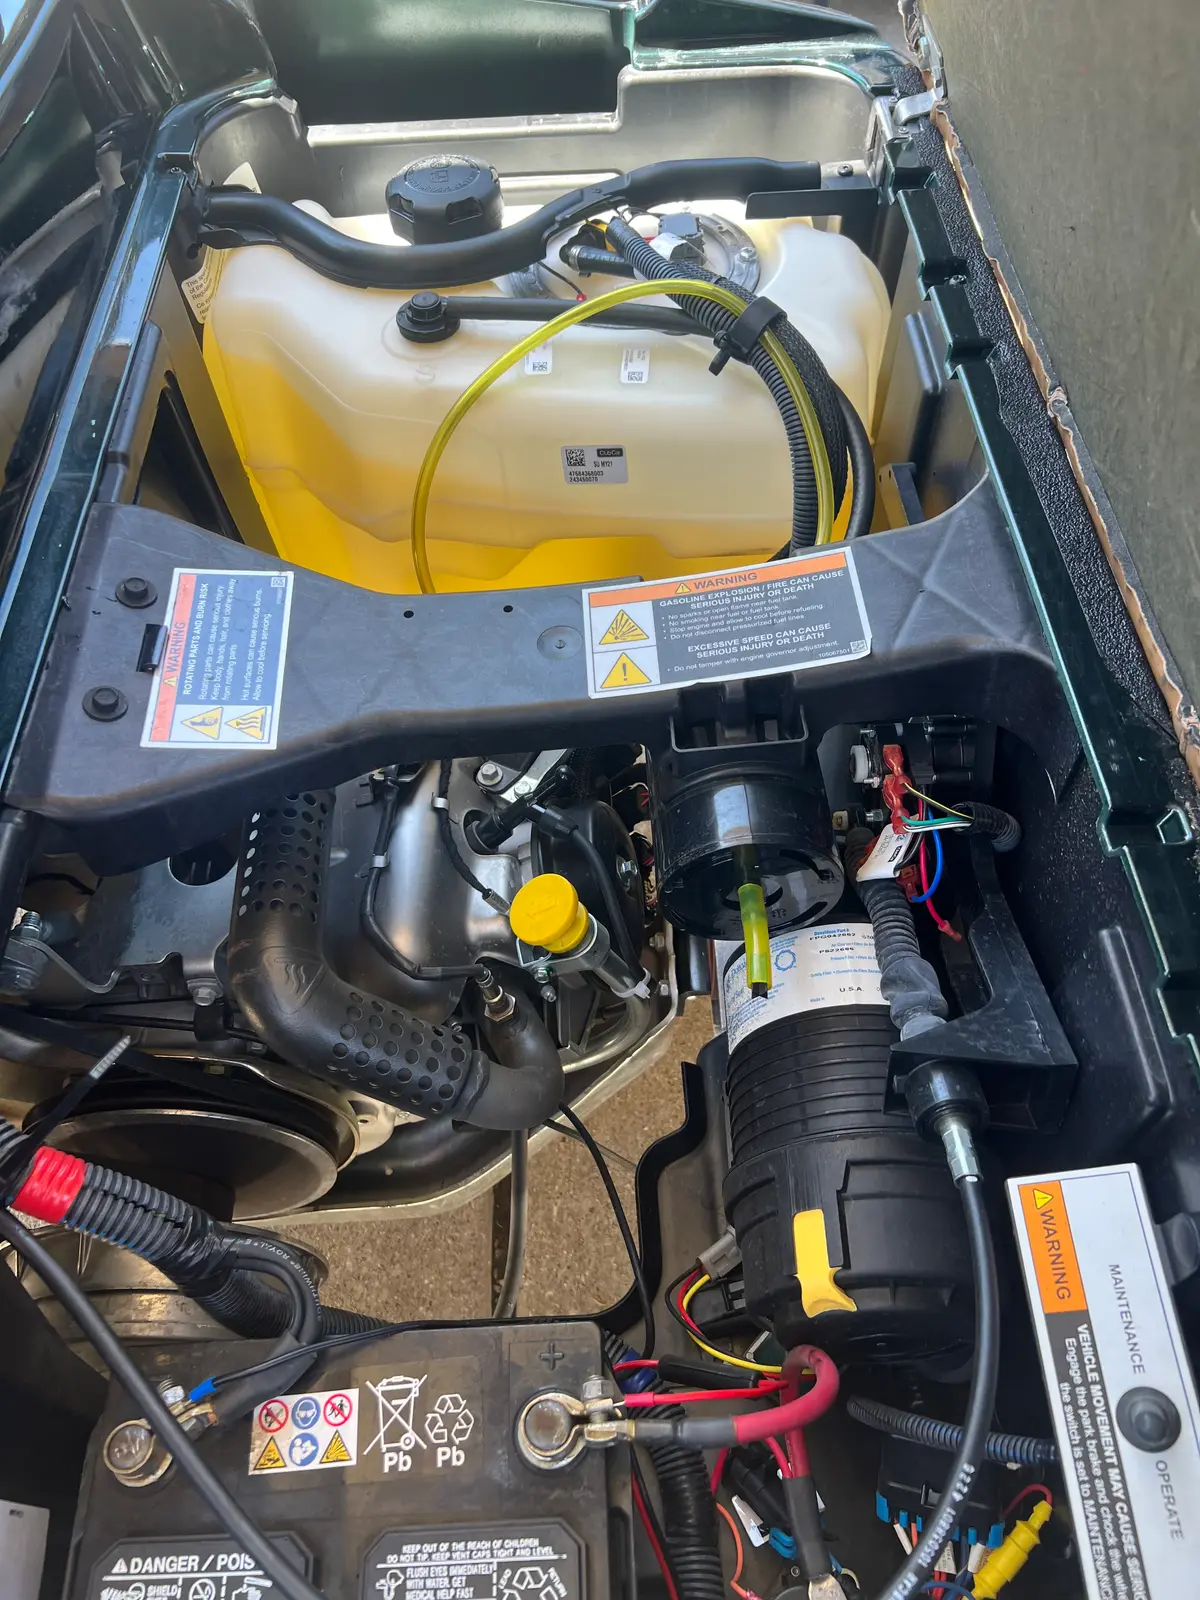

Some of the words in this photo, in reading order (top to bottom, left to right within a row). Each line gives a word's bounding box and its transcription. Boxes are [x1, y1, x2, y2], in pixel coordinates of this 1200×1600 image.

[199, 583, 209, 599] RISK
[660, 594, 707, 607] GASOLINE
[707, 585, 760, 600] EXPLOSION
[761, 584, 767, 592] /
[767, 580, 788, 590] FIRE
[789, 576, 810, 586] CAN
[811, 569, 845, 580] CAUSE
[693, 572, 758, 590] WARNING
[690, 597, 731, 610] SERIOUS
[732, 591, 766, 604] INJURY
[767, 589, 782, 598] OR
[783, 583, 815, 594] DEATH
[195, 600, 206, 619] BURN
[212, 602, 221, 624] serious
[251, 607, 261, 629] serious
[680, 610, 702, 620] sparks
[711, 606, 730, 615] open
[730, 602, 750, 610] flame
[750, 600, 767, 608] near
[680, 616, 709, 627] smoking
[710, 613, 726, 621] near
[726, 610, 740, 618] fuel
[749, 606, 763, 614] fuel
[193, 620, 203, 635] AND
[669, 626, 686, 634] Stop
[686, 622, 710, 632] engine
[711, 620, 725, 628] and
[726, 616, 744, 626] allow
[753, 612, 769, 621] cool
[769, 608, 792, 618] before
[670, 633, 681, 641] Do
[681, 631, 693, 639] not
[694, 626, 731, 638] disconnect
[732, 618, 773, 632] pressurized
[773, 616, 788, 625] fuel
[209, 624, 218, 643] cause
[210, 682, 222, 700] Keep
[222, 616, 230, 628] and
[227, 578, 237, 594] away
[249, 629, 258, 648] cause
[687, 638, 740, 653] EXCESSIVE
[741, 633, 773, 645] SPEED
[774, 629, 796, 639] CAN
[797, 622, 832, 635] CAUSE
[166, 622, 186, 673] WARNING
[189, 635, 201, 658] PARTS
[229, 644, 238, 660] parts
[247, 648, 255, 661] can
[256, 641, 268, 661] before
[673, 664, 685, 672] Do
[685, 662, 698, 671] not
[698, 659, 723, 669] tamper
[724, 656, 739, 665] with
[740, 653, 764, 662] engine
[765, 648, 797, 659] governor
[798, 640, 840, 653] adjustment.
[696, 646, 739, 659] SERIOUS
[740, 640, 774, 653] INJURY
[775, 637, 791, 647] OR
[792, 631, 825, 644] DEATH
[204, 656, 213, 672] parts
[225, 661, 237, 685] rotating
[243, 661, 254, 688] surfaces
[256, 661, 265, 676] cool
[183, 659, 197, 695] ROTATING
[198, 673, 213, 700] Rotating
[255, 675, 264, 683] to
[221, 685, 231, 700] from
[241, 689, 250, 700] Hot
[252, 684, 262, 700] Allow
[1040, 1208, 1071, 1300] WARNING
[1109, 1263, 1145, 1375] MAINTENANCE
[1064, 1337, 1083, 1385] Engage
[1077, 1323, 1100, 1383] VEHICLE
[1059, 1382, 1072, 1404] the
[1075, 1386, 1088, 1407] the
[1064, 1404, 1081, 1445] switch
[1077, 1408, 1096, 1438] park
[1089, 1384, 1120, 1468] MOVEMENT
[383, 1451, 412, 1473] Pb
[436, 1446, 465, 1468] Pb
[1072, 1447, 1084, 1459] is
[1086, 1438, 1103, 1477] brake
[1075, 1460, 1089, 1483] set
[1080, 1482, 1092, 1498] to
[1094, 1477, 1110, 1505] and
[1107, 1467, 1126, 1501] MAY
[1155, 1460, 1184, 1541] OPERATE
[1100, 1506, 1119, 1547] chock
[1115, 1501, 1138, 1556] CAUSE
[387, 1553, 399, 1564] DO
[399, 1553, 415, 1563] NOT
[431, 1551, 450, 1561] KEEP
[451, 1550, 470, 1560] VENT
[471, 1549, 491, 1559] CAPS
[493, 1548, 514, 1558] TIGHT
[515, 1547, 531, 1557] AND
[402, 1543, 421, 1554] KEEP
[421, 1543, 438, 1553] OUT
[438, 1542, 450, 1552] OF
[451, 1541, 466, 1551] THE
[467, 1540, 491, 1550] REACH
[492, 1539, 503, 1549] OF
[503, 1537, 539, 1549] CHILDREN
[1083, 1500, 1115, 1600] MAINTENANC
[129, 1555, 199, 1574] DANGER
[201, 1554, 215, 1572] /
[216, 1552, 254, 1571] POIS
[406, 1566, 429, 1578] FLUSH
[429, 1565, 449, 1577] EYES
[449, 1563, 494, 1577] IMMEDIATELY
[1108, 1547, 1122, 1572] the
[406, 1578, 424, 1590] WITH
[451, 1576, 466, 1588] GET
[498, 1568, 512, 1590] LEAD
[547, 1566, 568, 1598] RETURN
[146, 1584, 178, 1597] SHIELD
[405, 1589, 435, 1600] MEDICAL
[436, 1588, 455, 1600] HELP
[455, 1586, 474, 1599] FAST
